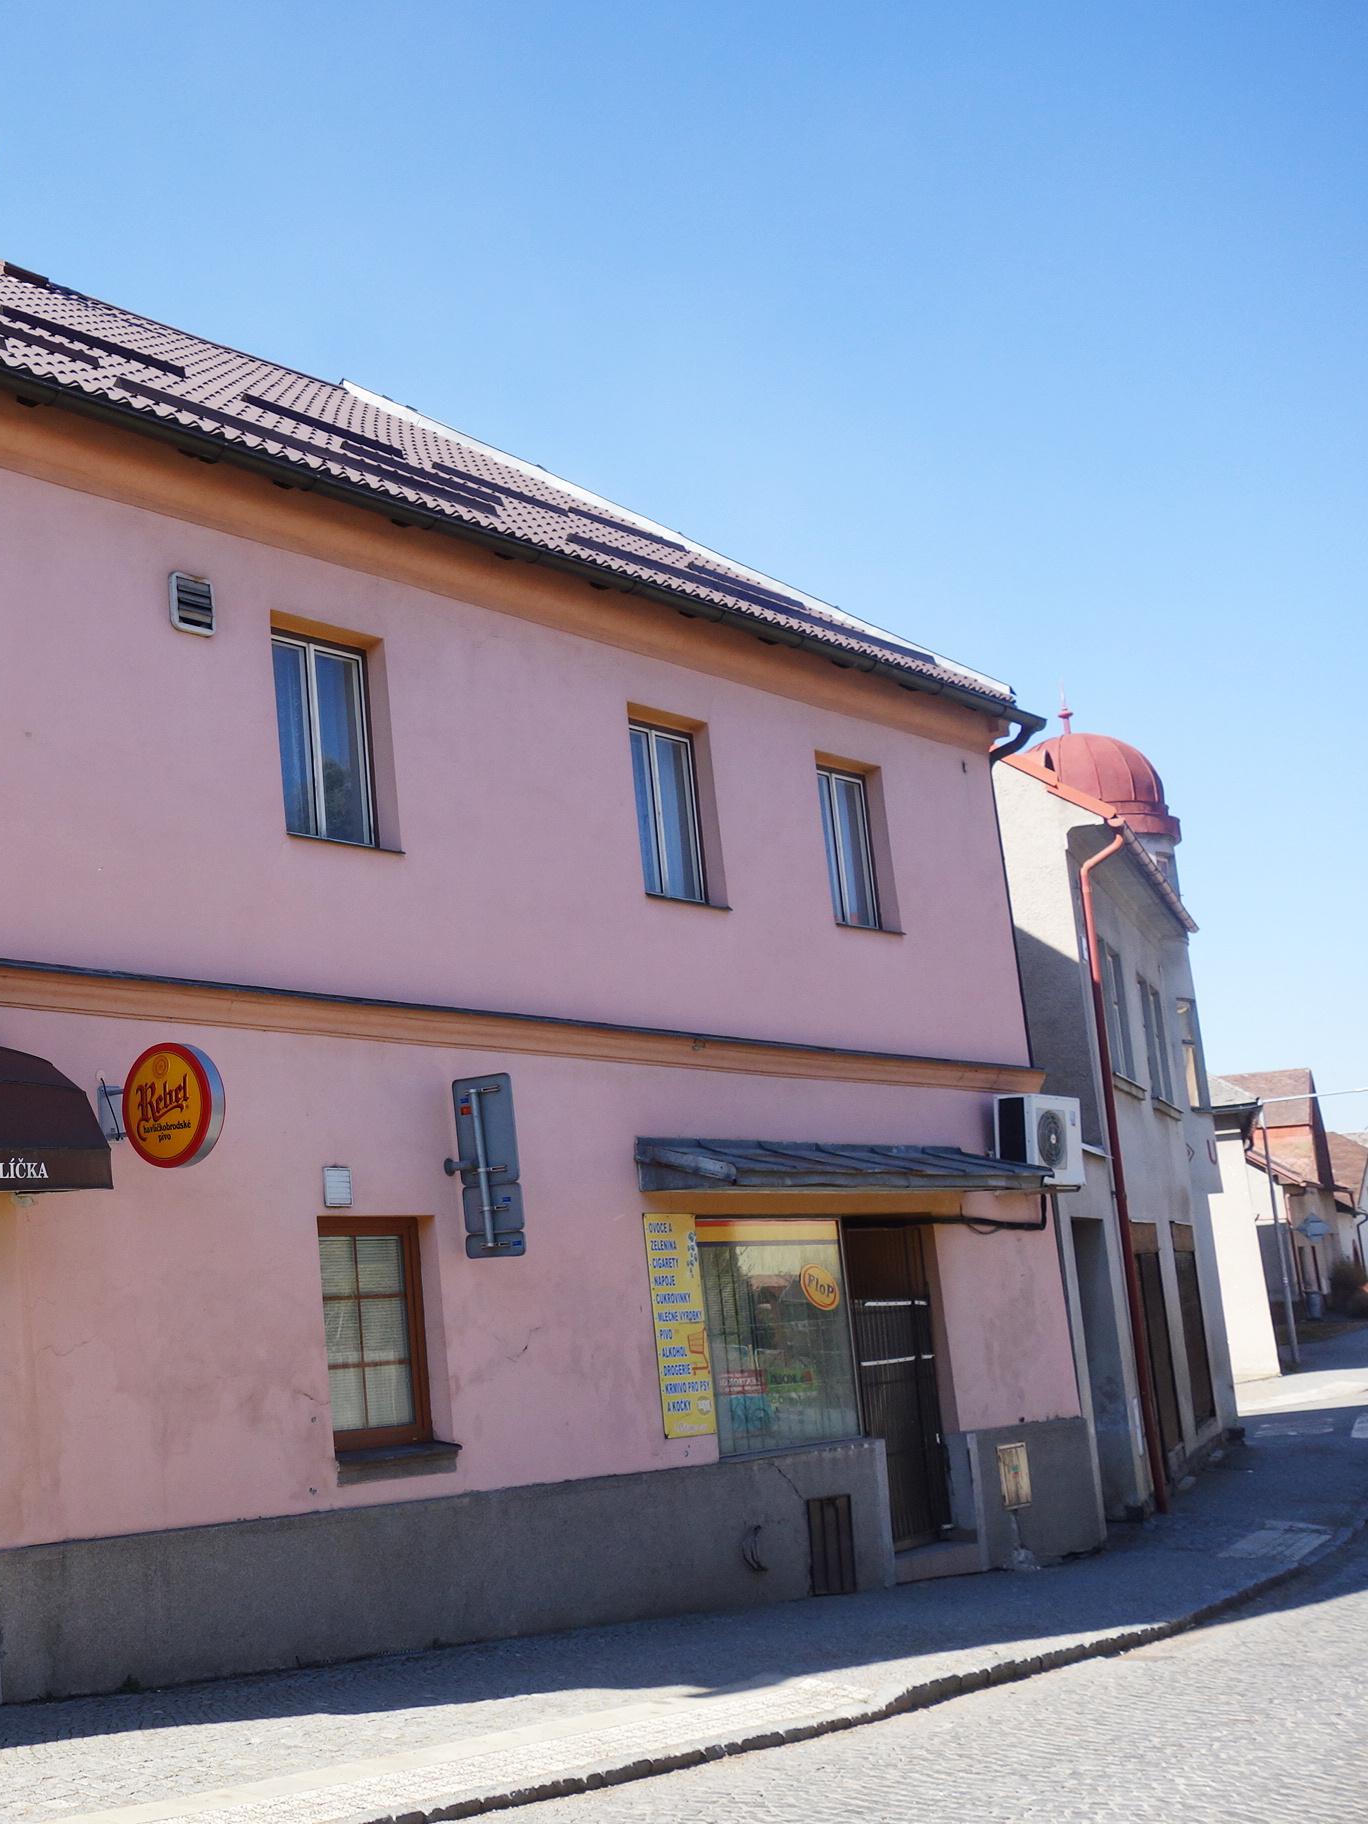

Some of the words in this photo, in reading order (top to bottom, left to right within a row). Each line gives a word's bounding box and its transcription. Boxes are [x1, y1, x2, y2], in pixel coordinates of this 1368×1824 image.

[136, 1073, 190, 1141] Rebel
[158, 1132, 172, 1143] pivo
[650, 1240, 677, 1251] ZELENINA
[659, 1328, 672, 1340] PIVO
[662, 1346, 688, 1358] ALKOHOL
[663, 1363, 691, 1376] DROGERIE
